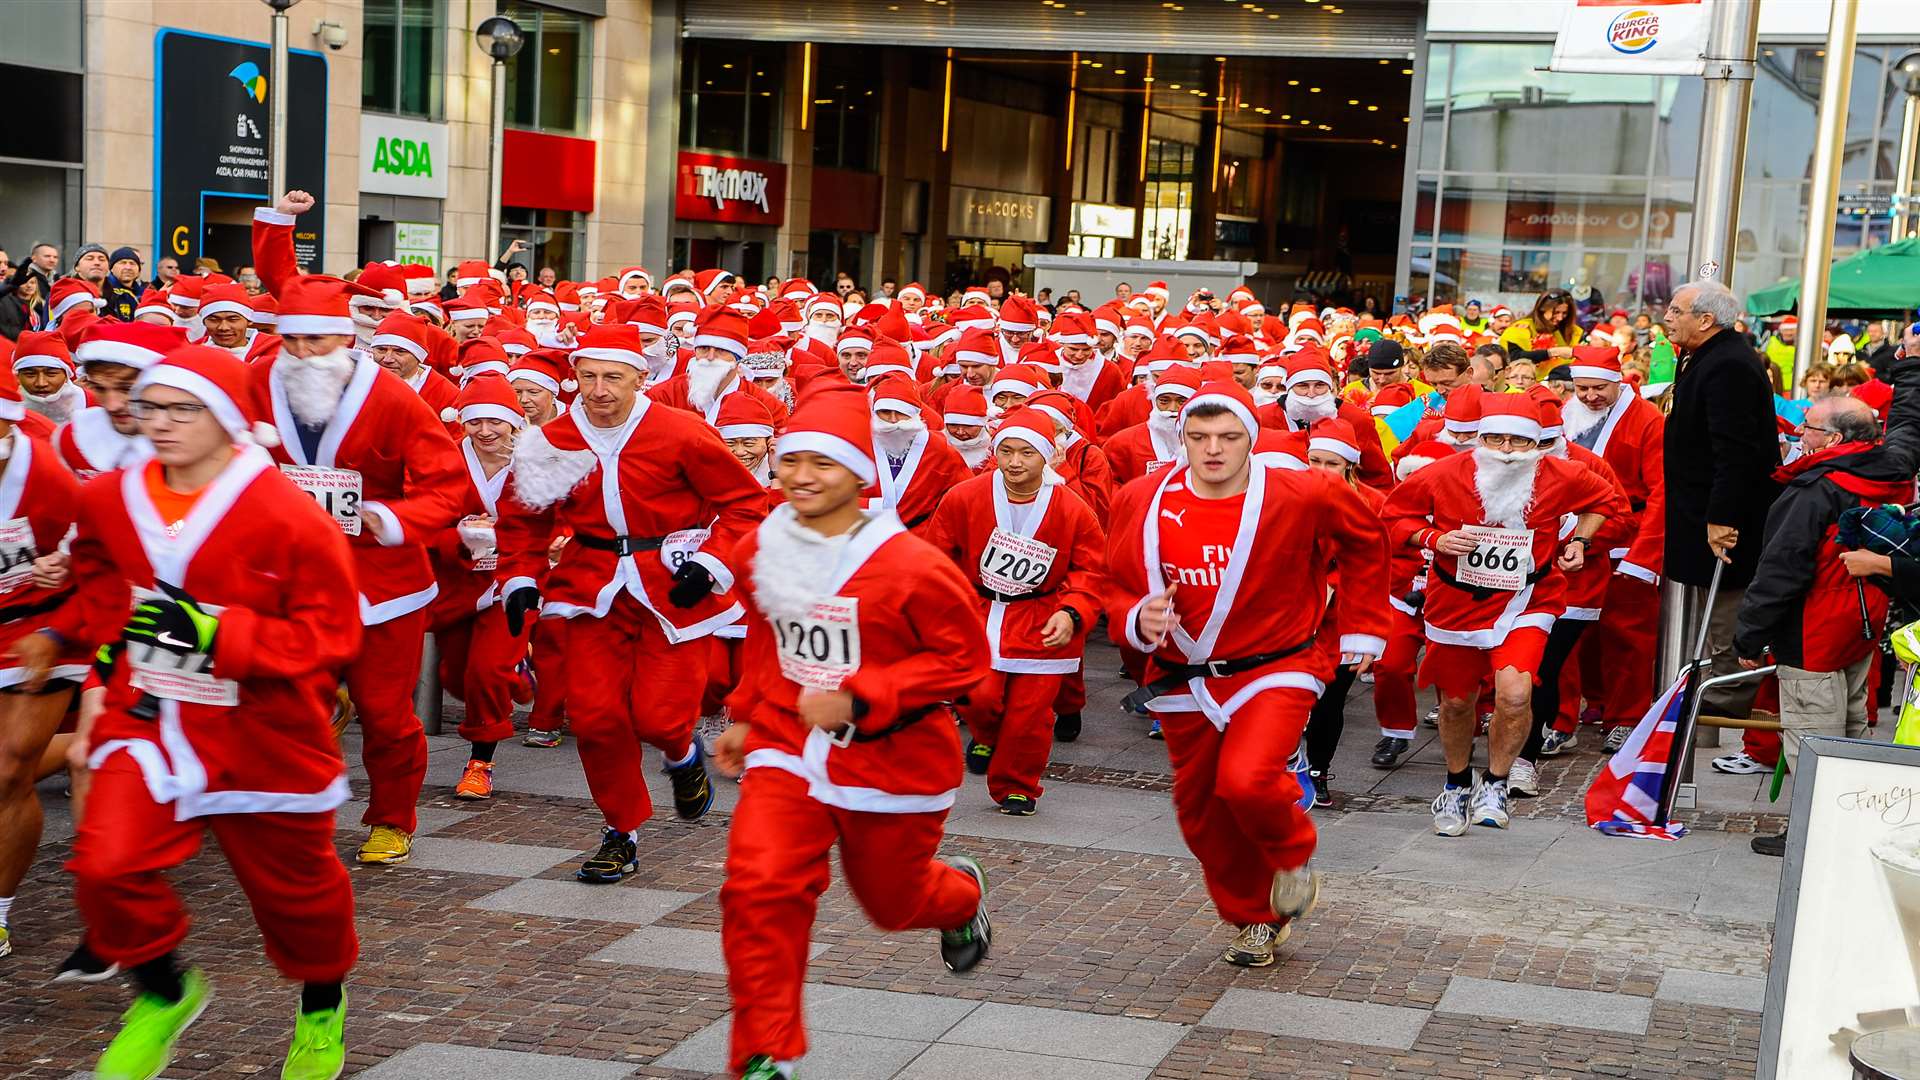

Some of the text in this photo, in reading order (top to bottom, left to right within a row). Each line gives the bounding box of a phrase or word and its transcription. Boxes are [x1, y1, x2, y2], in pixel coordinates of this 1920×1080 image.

[1612, 24, 1660, 42] KING
[1613, 16, 1659, 31] BURGER
[372, 136, 433, 178] ASDA
[233, 167, 244, 177] CAR
[245, 169, 258, 179] PARK
[968, 201, 1034, 219] PEACOCKS
[173, 225, 189, 256] G
[303, 490, 359, 517] 13
[991, 538, 1018, 551] SANTAS
[1018, 548, 1034, 557] FUN
[1035, 554, 1051, 562] RUN
[993, 532, 1025, 547] CHANNEL
[1026, 543, 1055, 556] ROTARY
[984, 546, 1047, 585] 1202
[1467, 544, 1519, 572] 666
[776, 619, 850, 664] 1201
[1837, 786, 1919, 825] Fancy
